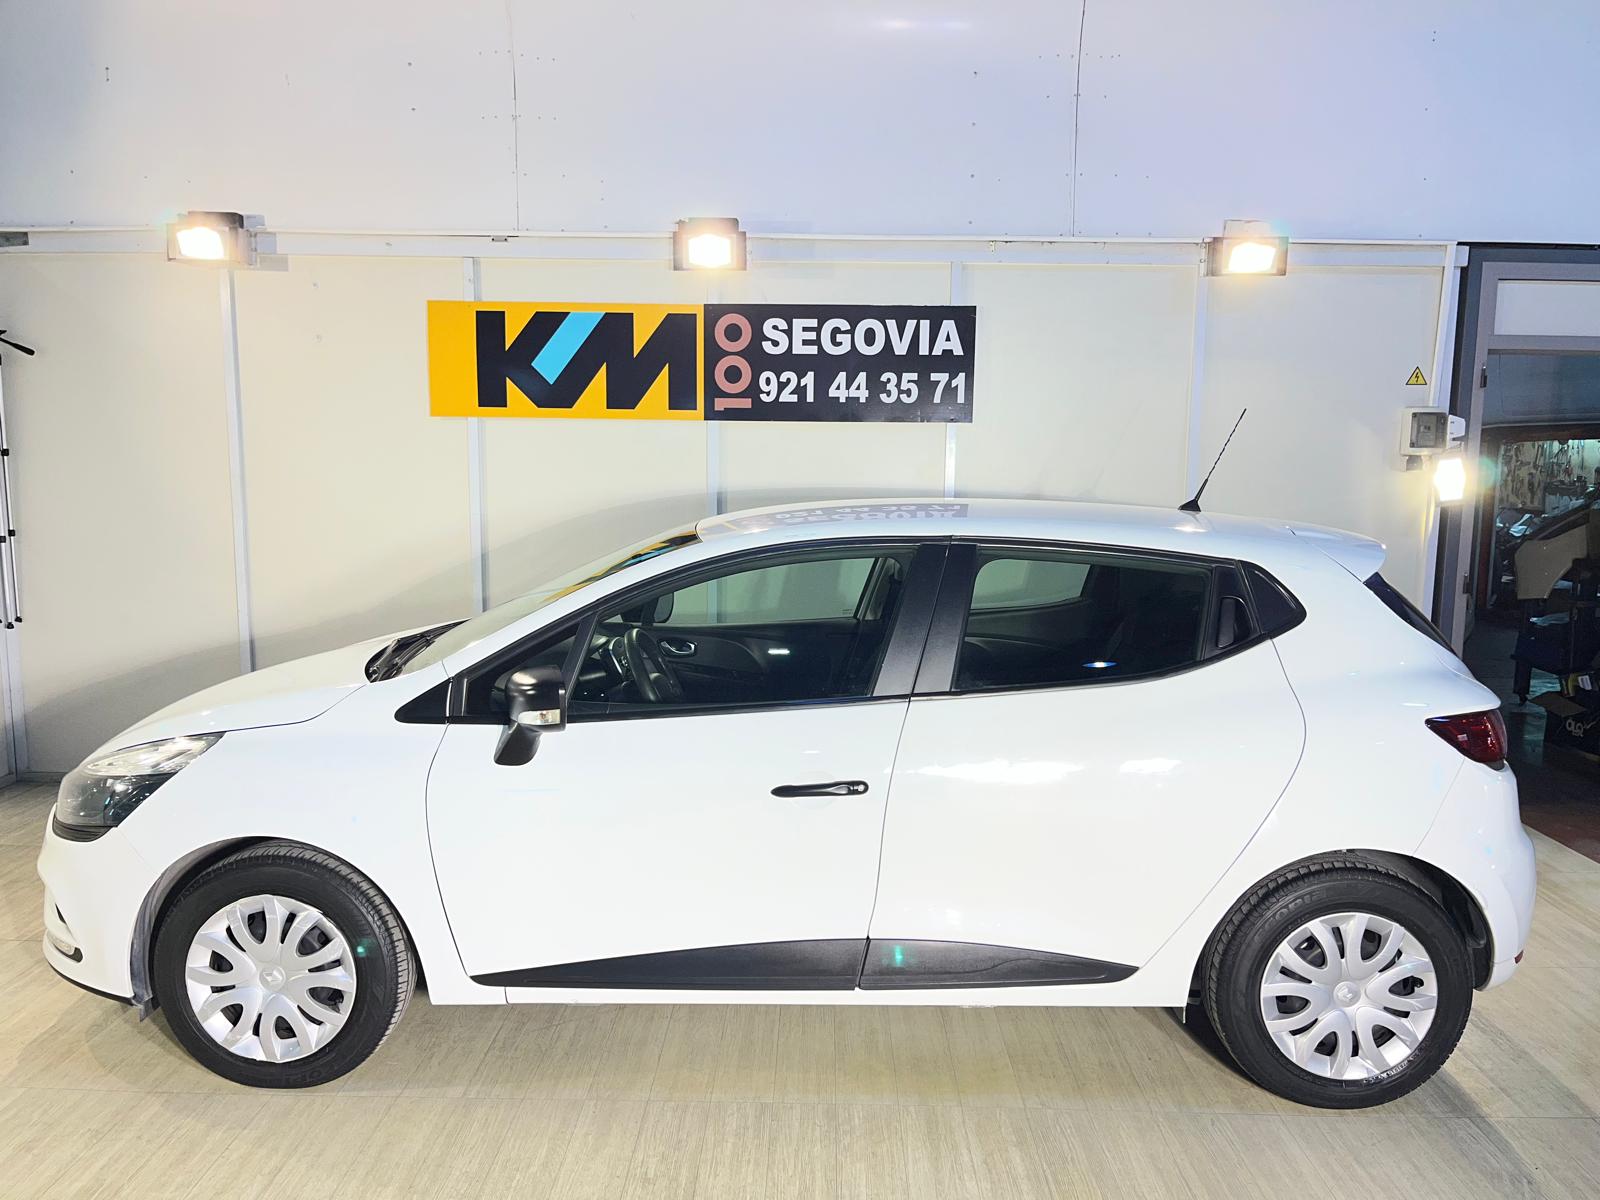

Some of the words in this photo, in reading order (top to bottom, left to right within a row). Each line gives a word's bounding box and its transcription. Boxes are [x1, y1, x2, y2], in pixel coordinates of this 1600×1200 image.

[476, 311, 698, 410] KM
[714, 313, 752, 411] 100
[761, 318, 964, 356] SEGOVIA
[759, 371, 815, 403] 921
[828, 372, 869, 403] 44
[879, 372, 919, 404] 35
[930, 372, 966, 404] 71
